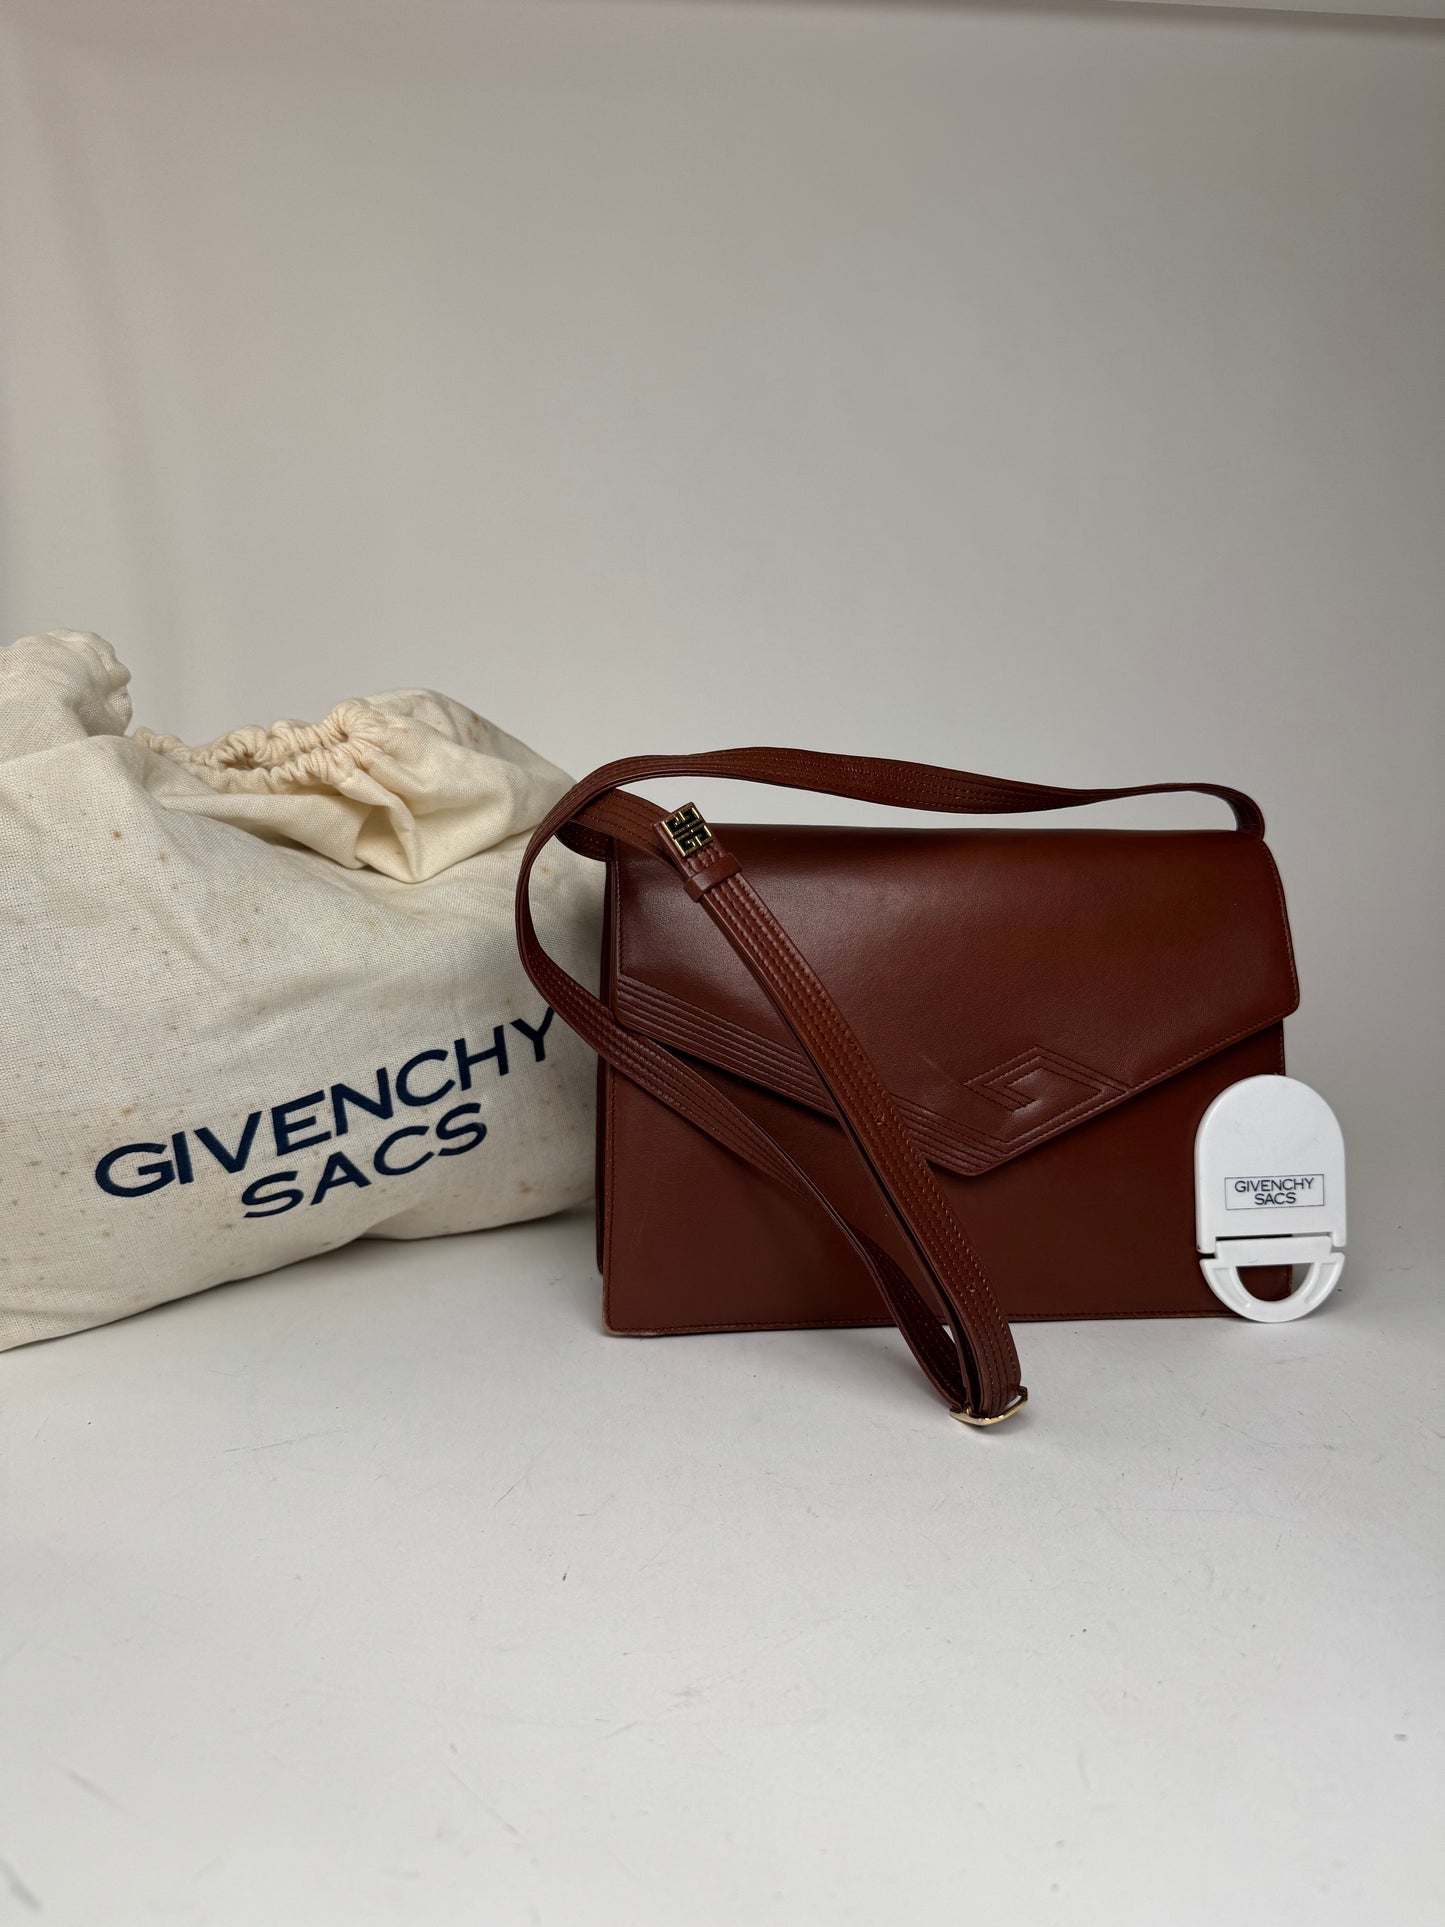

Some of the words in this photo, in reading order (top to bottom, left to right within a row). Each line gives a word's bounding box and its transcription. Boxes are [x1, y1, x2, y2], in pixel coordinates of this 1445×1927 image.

[95, 1007, 554, 1197] GIVENCHY
[242, 1102, 488, 1219] SACS
[1234, 1177, 1314, 1193] GIVENCHY
[1254, 1192, 1296, 1205] SACS
